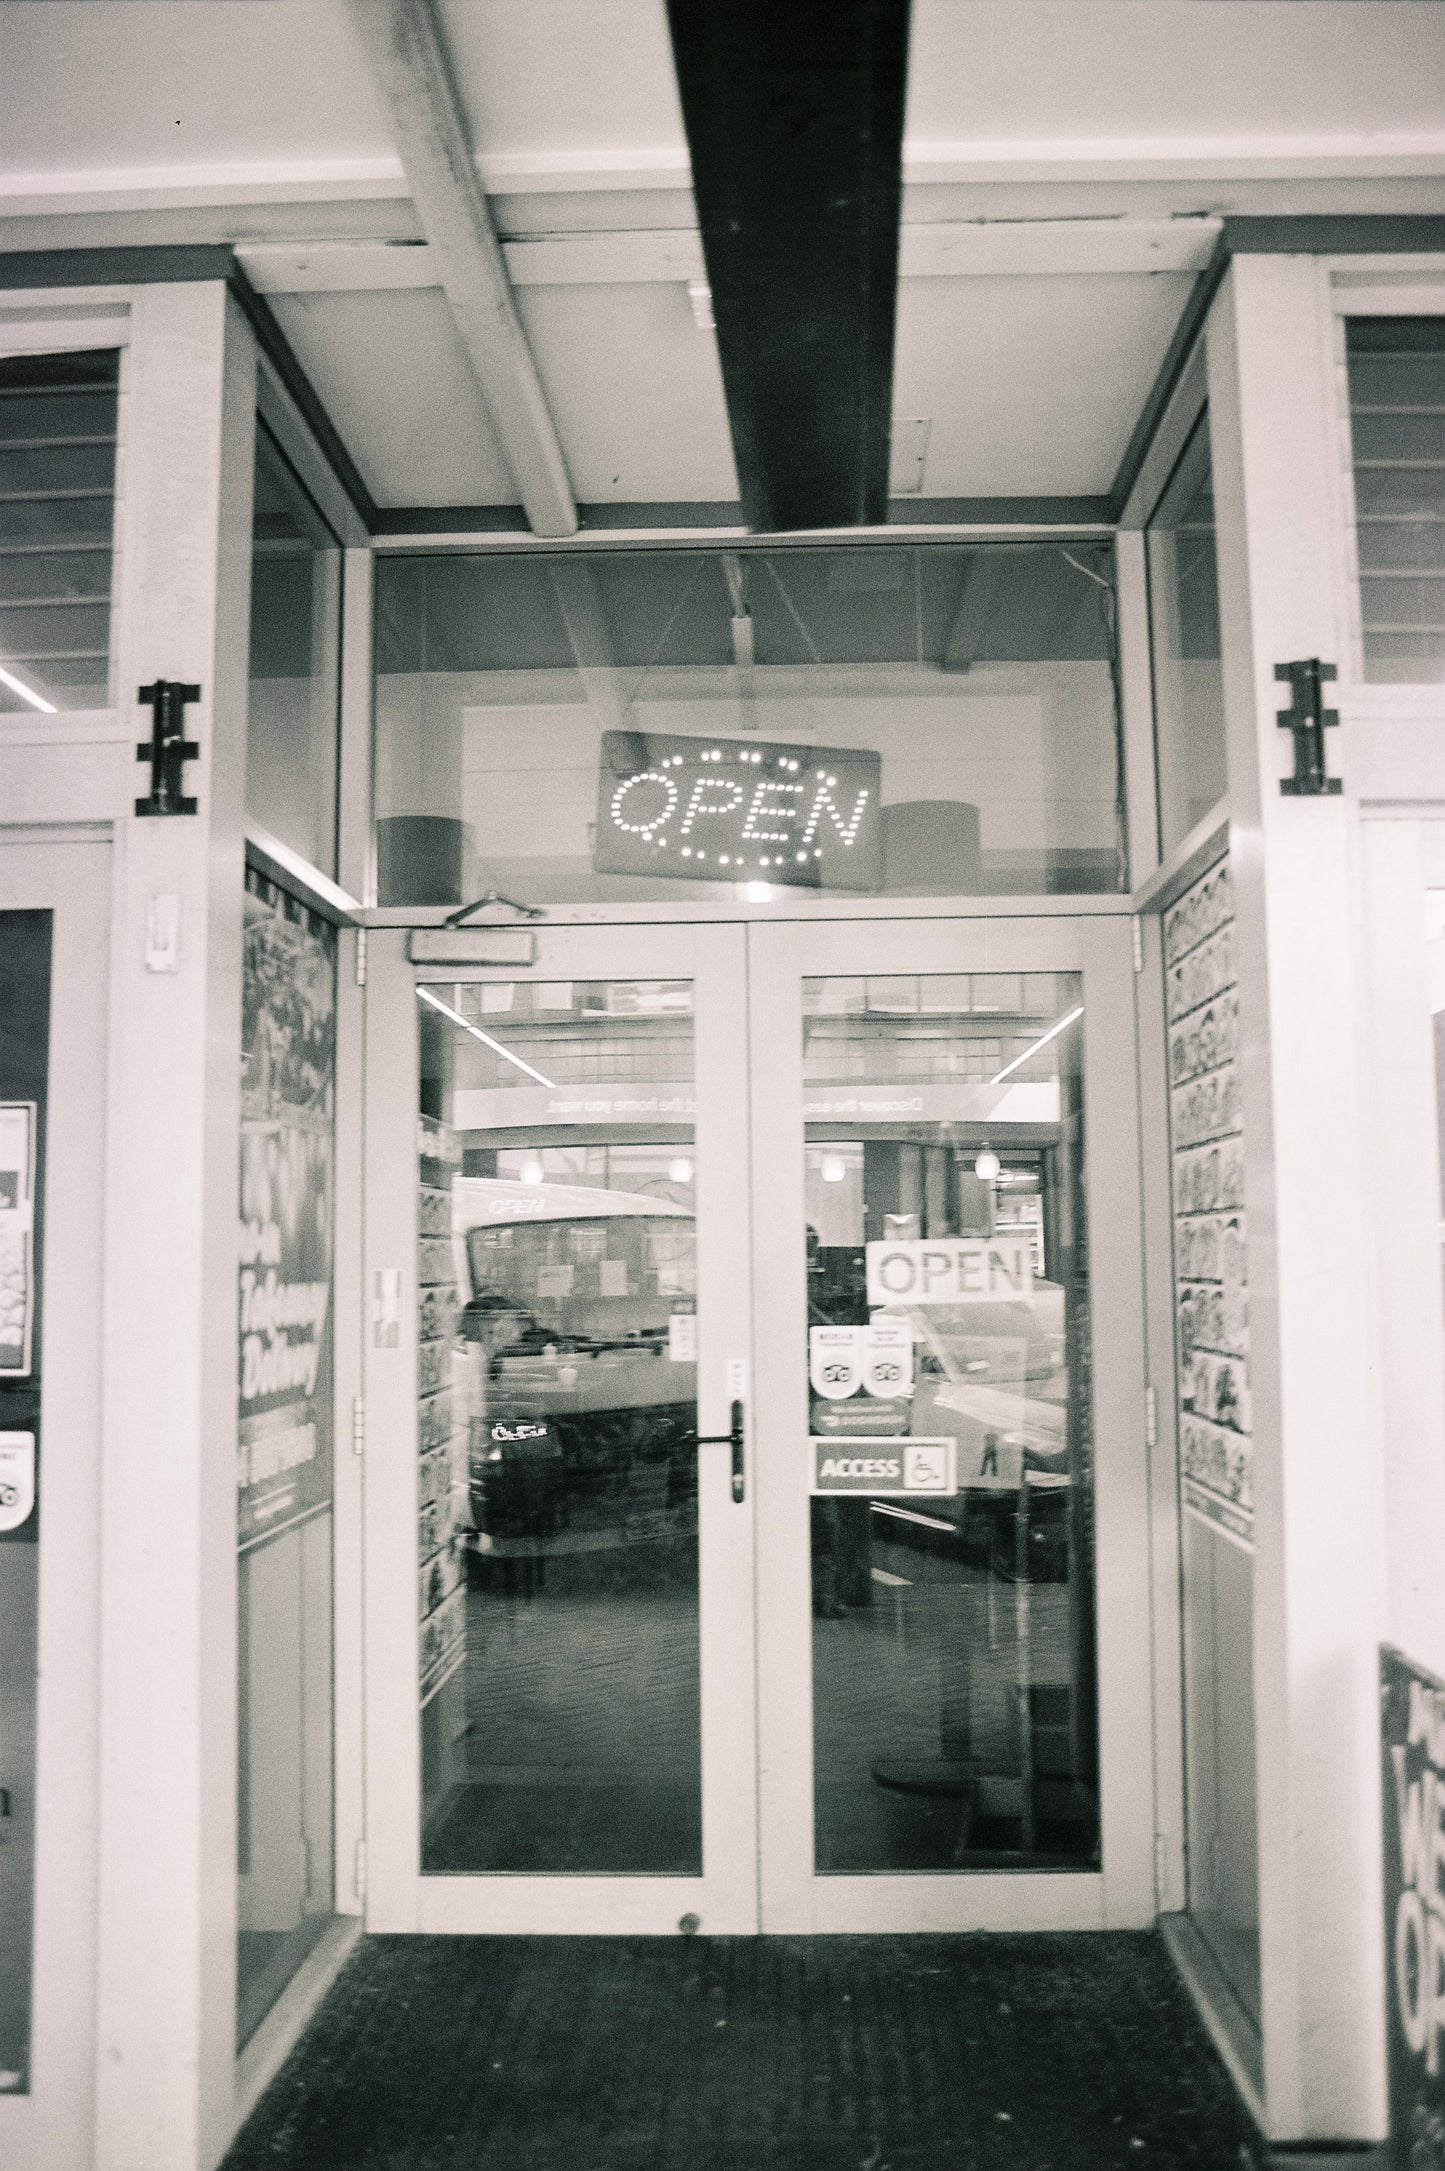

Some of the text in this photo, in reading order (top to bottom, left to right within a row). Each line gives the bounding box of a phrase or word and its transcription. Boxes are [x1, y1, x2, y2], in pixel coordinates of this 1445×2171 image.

[611, 773, 869, 846] OPEN
[879, 1250, 1024, 1294] OPEN
[820, 1458, 900, 1478] ACCESS
